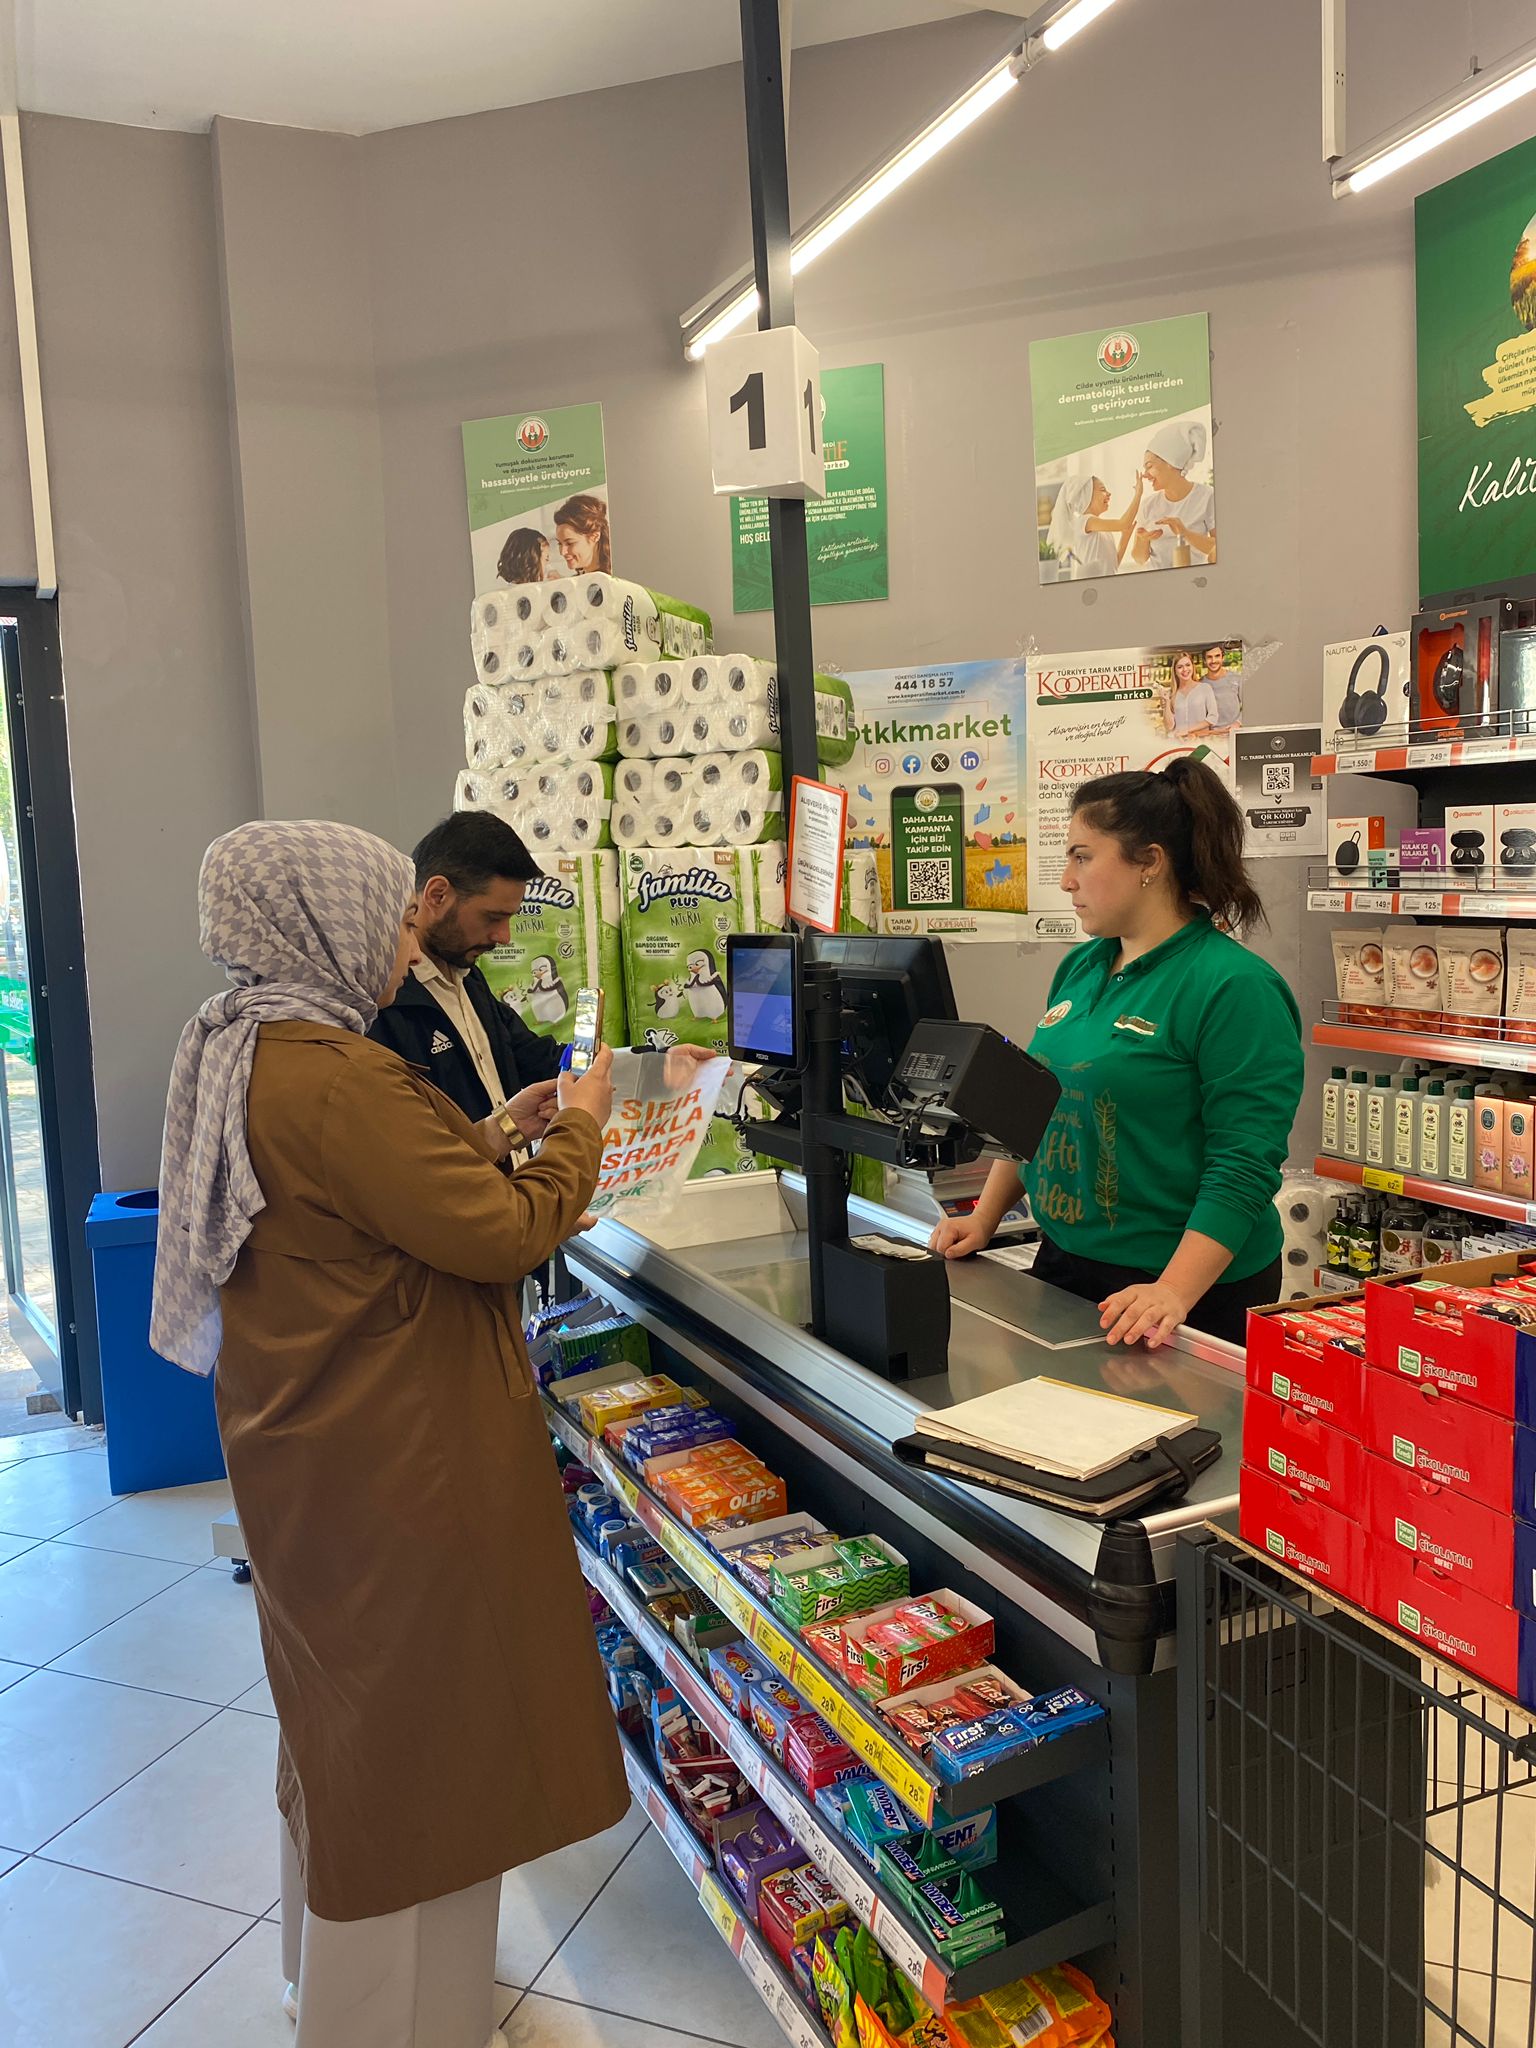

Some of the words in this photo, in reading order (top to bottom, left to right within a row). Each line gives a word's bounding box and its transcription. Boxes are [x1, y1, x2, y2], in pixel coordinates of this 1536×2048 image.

[1058, 385, 1125, 405] dermatolojik
[1128, 377, 1184, 395] testlerden
[1075, 382, 1093, 391] Cilde
[1095, 377, 1120, 388] uyumlu
[1501, 381, 1523, 393] uzman
[730, 372, 766, 450] 1
[1091, 395, 1151, 413] geçiriyoruz
[803, 379, 816, 456] 1
[481, 473, 539, 489] hassasiyetle
[541, 467, 591, 481] üretiyoruz
[740, 533, 753, 545] HOŞ
[623, 595, 637, 652] familia
[1325, 644, 1357, 656] NAUTICA
[1057, 668, 1087, 678] TÜRKİYE
[1089, 666, 1111, 675] TARIM
[1113, 664, 1135, 673] KREDİ
[894, 680, 918, 691] 444
[921, 678, 935, 689] 18
[938, 677, 954, 688] 57
[1114, 691, 1150, 700] market
[1038, 755, 1129, 781] KOOPKART
[1038, 791, 1062, 800] daha
[1039, 782, 1049, 791] ile
[902, 816, 927, 825] DAHA
[927, 814, 954, 824] FAZLA
[904, 825, 952, 834] KAMPANYA
[906, 844, 930, 854] TAKİP
[930, 843, 952, 853] EDİN
[911, 835, 928, 845] İÇİN
[929, 834, 946, 843] BİZİ
[638, 867, 732, 912] familia
[669, 897, 699, 908] PLUS
[712, 1039, 723, 1048] 40
[621, 1088, 702, 1121] SIFIR
[602, 1129, 696, 1170] SRAFA
[1422, 1363, 1477, 1388] ÇİKOLATALI
[1291, 1388, 1334, 1412] ÇİKOLATALI
[1394, 1448, 1412, 1461] Kredi
[1395, 1439, 1414, 1454] Tarım
[1288, 1465, 1331, 1491] ÇİKOLATALI
[1416, 1455, 1470, 1483] ÇİKOLATALI
[1397, 1521, 1417, 1536] Tarım
[1397, 1530, 1415, 1543] Kredi
[1286, 1546, 1331, 1575] ÇİKOLATALI
[1419, 1538, 1473, 1570] ÇİKOLATALI
[815, 1593, 843, 1614] First
[911, 1603, 945, 1620] First
[1400, 1605, 1418, 1621] Tarım
[1401, 1614, 1418, 1628] Kredi
[1422, 1623, 1477, 1657] ÇİKOLATALI
[846, 1644, 865, 1665] First
[900, 1655, 929, 1681] First
[973, 1680, 1010, 1703] First
[1050, 1690, 1085, 1714] First
[902, 1708, 937, 1730] First
[1018, 1704, 1034, 1714] 60
[813, 1715, 842, 1746] VIVIDENT
[945, 1721, 985, 1746] First
[998, 1723, 1014, 1733] 60
[954, 1732, 987, 1750] INFINITY
[866, 1789, 880, 1812] EXTRA
[908, 1785, 918, 1802] 28
[874, 1785, 901, 1827] VIVIDENT
[884, 1840, 926, 1880] VIVIDENT
[920, 1882, 967, 1924] VIVIDENT
